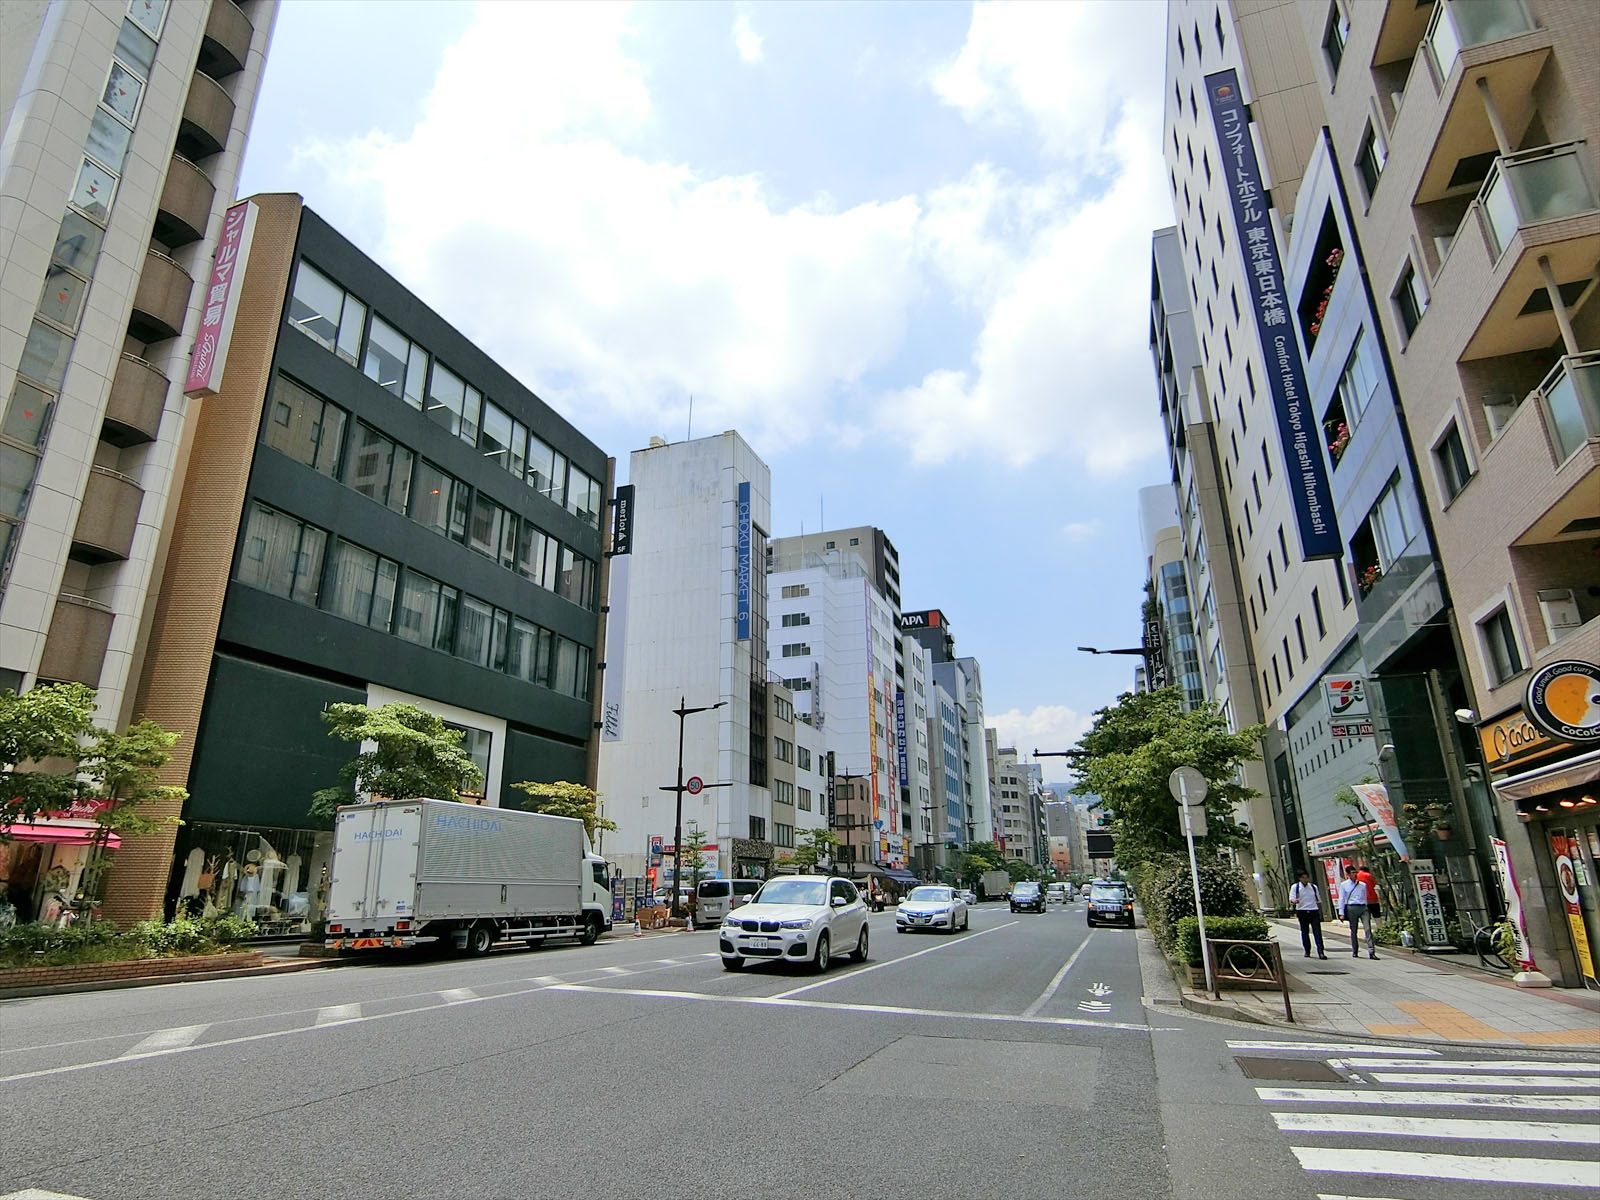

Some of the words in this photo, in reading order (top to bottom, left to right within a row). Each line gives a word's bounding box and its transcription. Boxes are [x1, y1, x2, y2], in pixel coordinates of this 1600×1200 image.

[1221, 109, 1262, 223] コンフォートホテル
[1246, 227, 1287, 326] 東京東日本橋
[1274, 335, 1291, 373] Comfort
[1282, 374, 1298, 400] Hotel
[1288, 400, 1302, 430] Tokyo
[1294, 432, 1313, 471] Higashi
[619, 500, 627, 531] merlot
[1303, 472, 1327, 535] Nihombashi
[617, 545, 626, 553] 5F
[738, 554, 749, 605] MARKET
[738, 613, 749, 621] 6
[901, 615, 924, 626] APA
[1535, 686, 1543, 705] Good
[1552, 665, 1572, 675] Good
[1573, 666, 1594, 675] curry
[690, 782, 700, 790] 50
[354, 828, 403, 840] HACHDAI
[437, 816, 502, 832] HACHIDAI
[1421, 893, 1440, 916] 会社印
